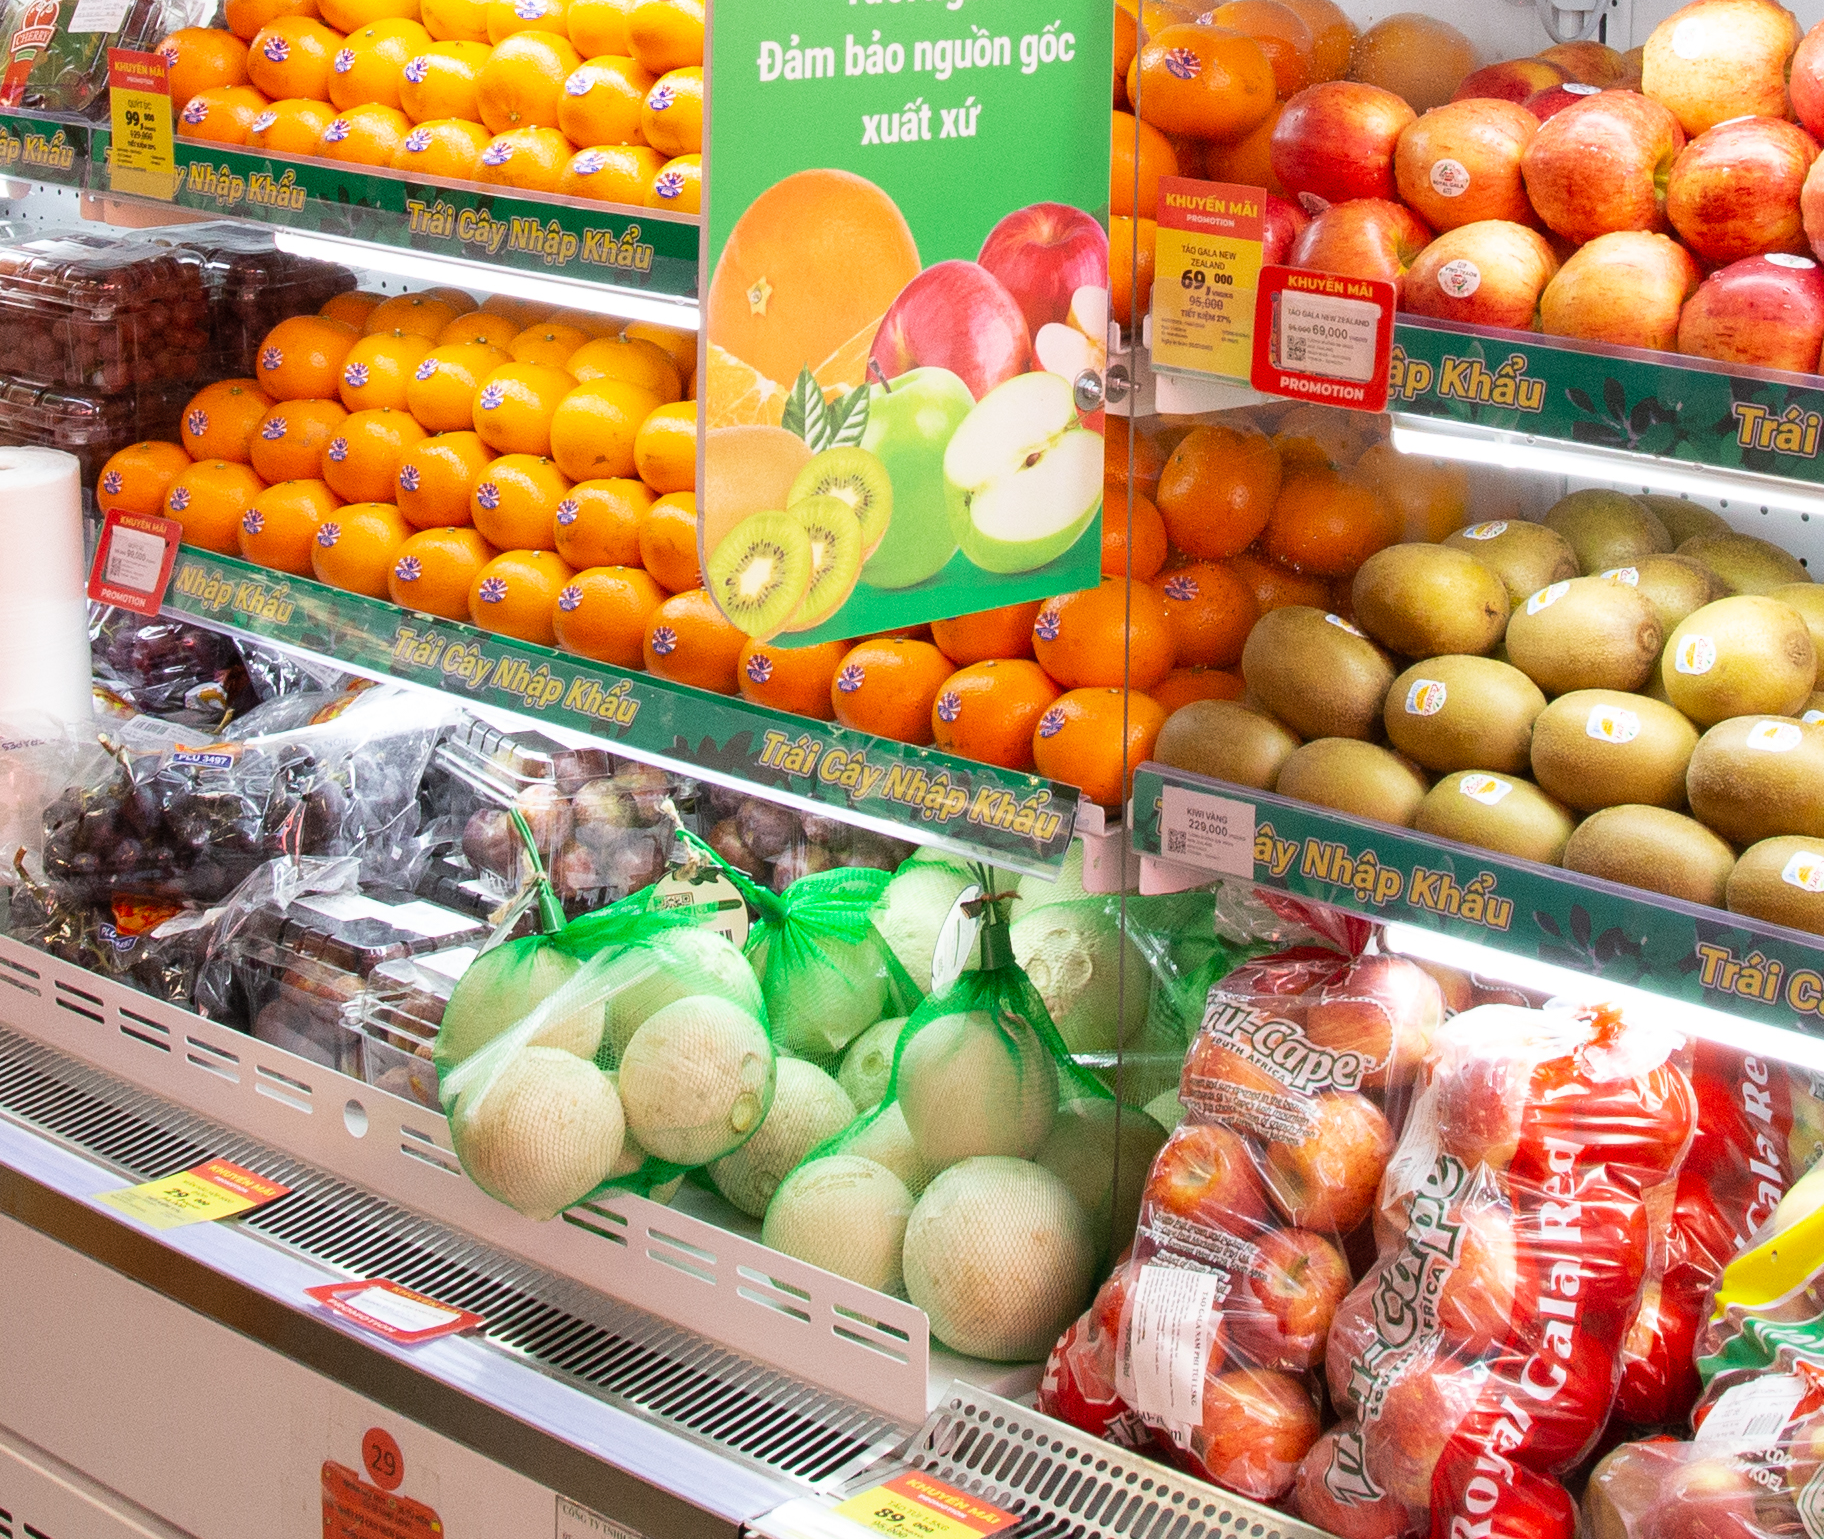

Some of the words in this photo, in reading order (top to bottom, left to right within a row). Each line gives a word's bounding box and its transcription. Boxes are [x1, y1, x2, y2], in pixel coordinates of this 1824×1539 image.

[10, 27, 56, 53] CHERRY
[756, 38, 835, 84] Đảm
[843, 28, 906, 76] bảo
[911, 23, 1012, 84] nguồn
[1017, 18, 1077, 76] gốc
[861, 102, 933, 146] xuất
[938, 99, 983, 141] xứ
[20, 131, 75, 170] Khẩu
[186, 161, 245, 206] Nhập
[247, 170, 307, 213] Khẩu
[407, 198, 454, 239] Trái
[457, 208, 507, 252] Cây
[508, 216, 579, 265] Nhập
[583, 226, 654, 275] Khẩu
[1280, 375, 1364, 401] PROMOTION
[99, 585, 149, 610] PROMOTION
[230, 577, 295, 628] Khẩu
[393, 627, 442, 670] Trái
[444, 639, 494, 685] Cây
[496, 654, 565, 710] Nhập
[566, 674, 641, 728] Khẩu
[175, 753, 200, 767] PLU
[202, 754, 232, 768] 3497
[1697, 944, 1782, 1005] Trái
[1539, 1136, 1584, 1243] Red
[1520, 1259, 1581, 1401] Gala
[1449, 1394, 1533, 1539] Royal
